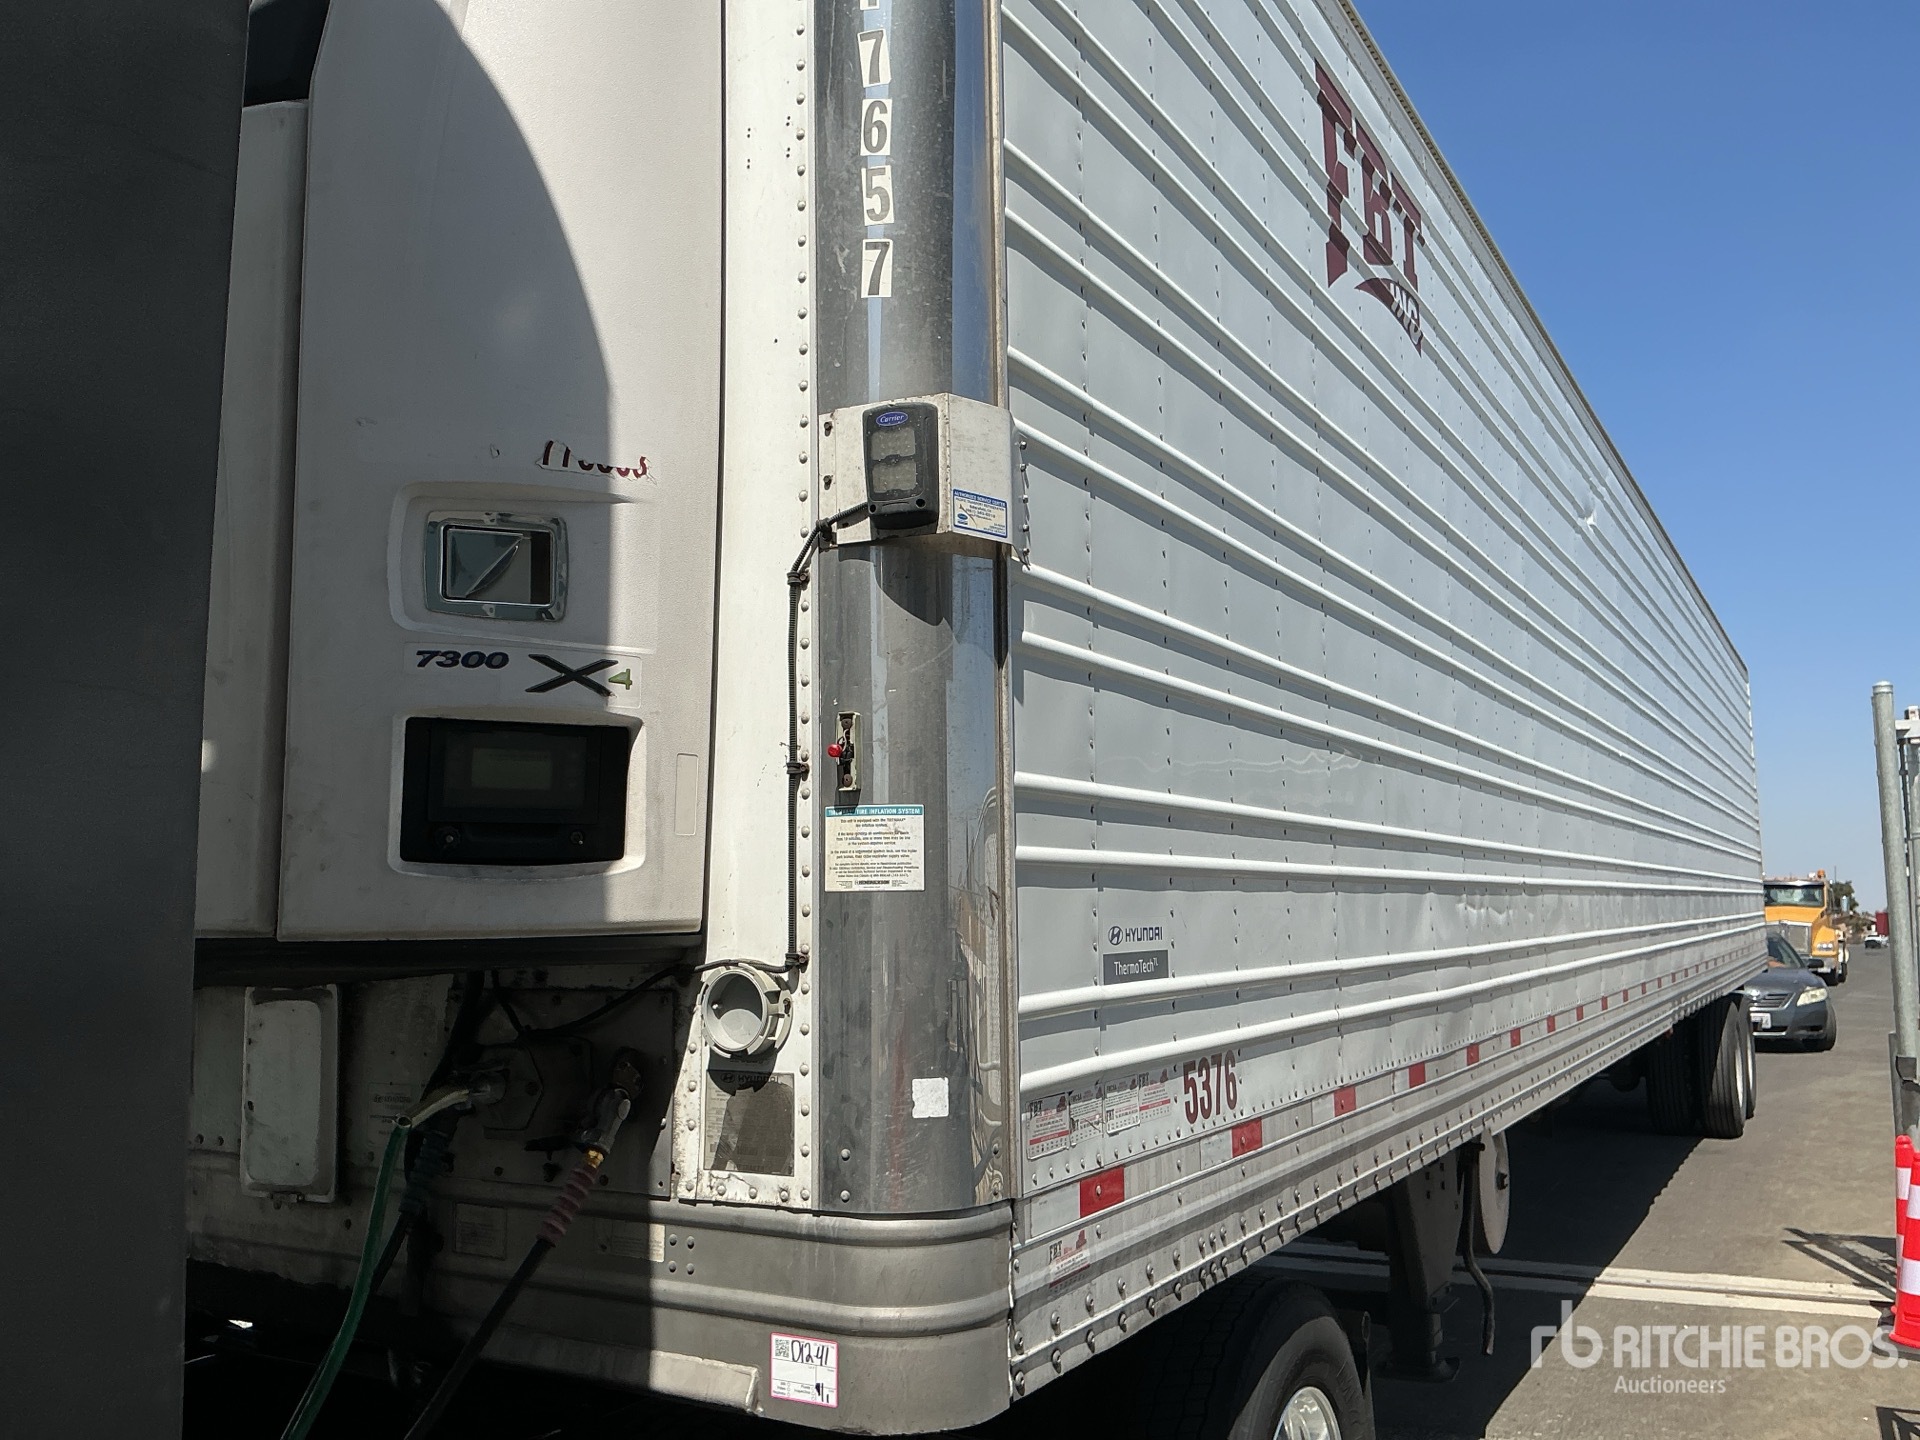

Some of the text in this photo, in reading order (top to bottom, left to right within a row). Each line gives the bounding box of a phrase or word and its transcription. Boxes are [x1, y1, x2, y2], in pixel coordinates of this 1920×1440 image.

[1315, 59, 1425, 293] FBT
[879, 414, 905, 423] Carrier
[415, 650, 510, 669] 7300
[1125, 926, 1163, 942] HYUNDAI
[1182, 1050, 1237, 1124] 5376
